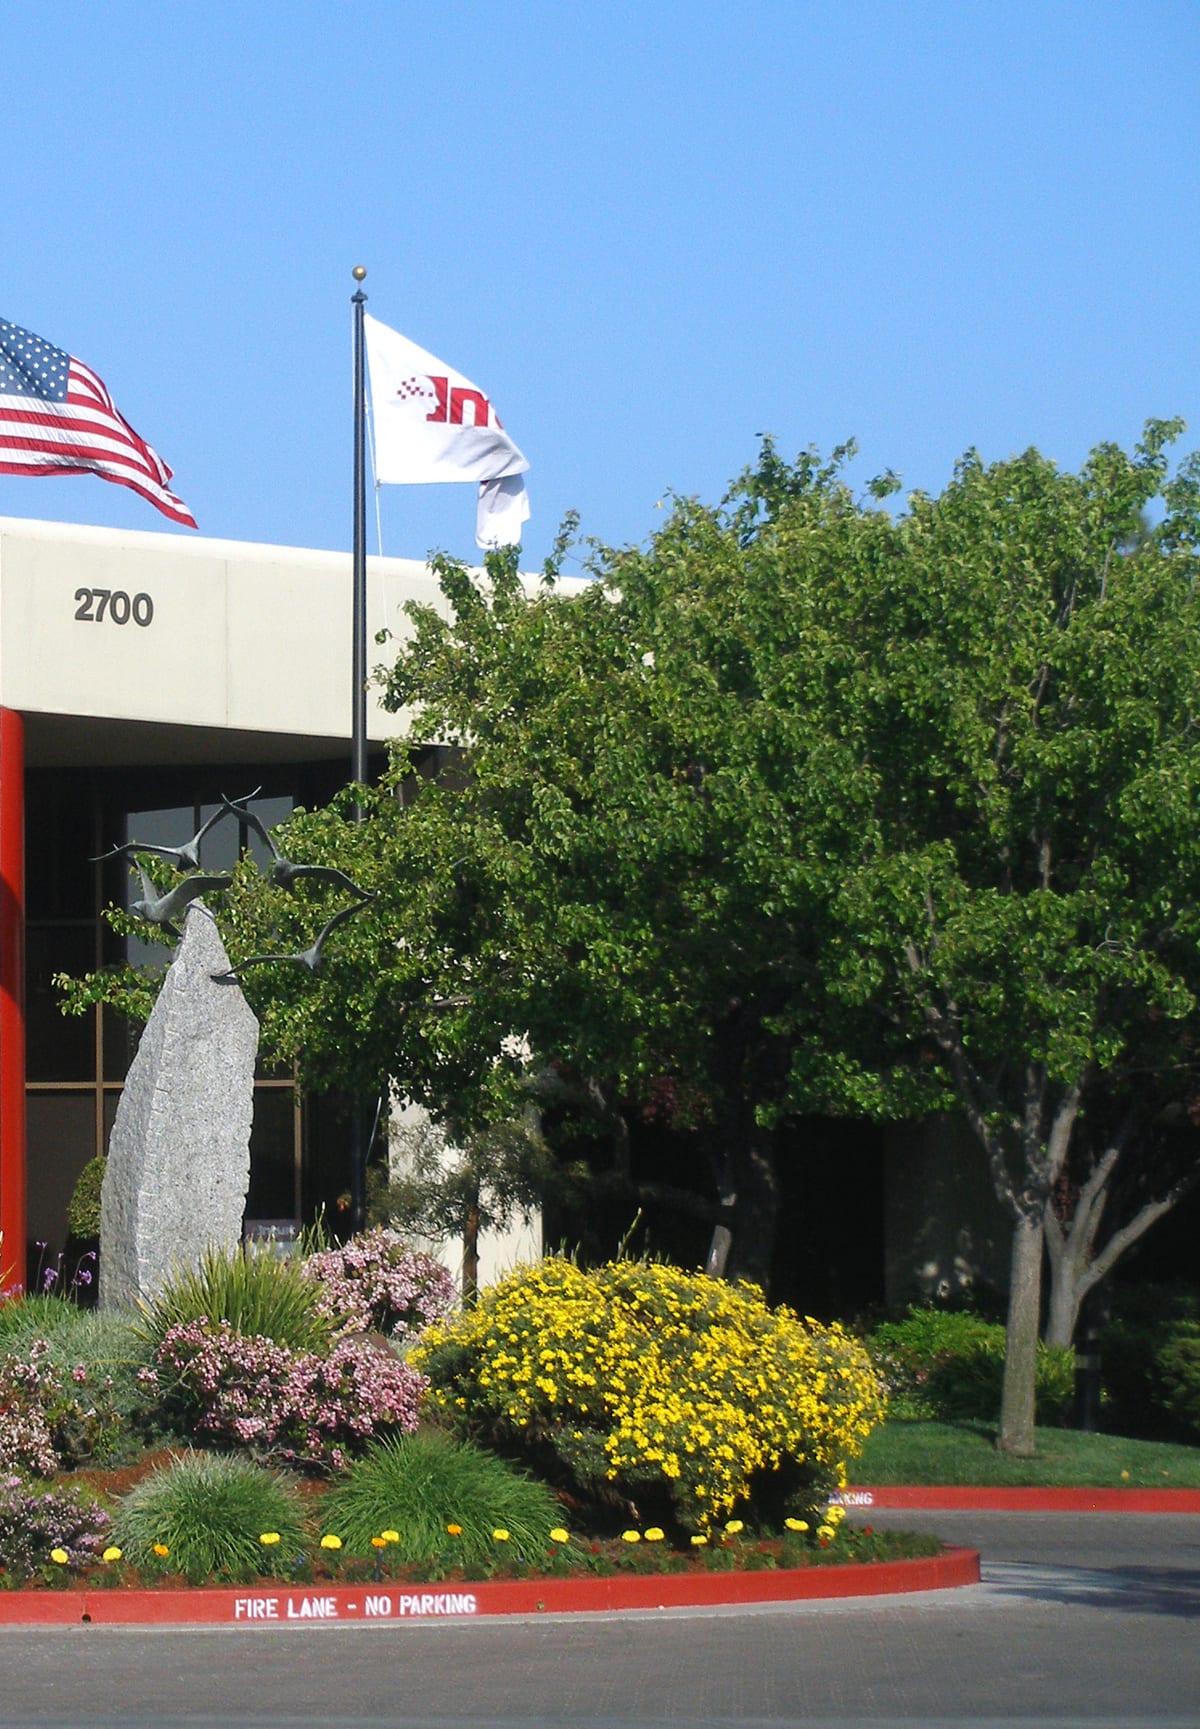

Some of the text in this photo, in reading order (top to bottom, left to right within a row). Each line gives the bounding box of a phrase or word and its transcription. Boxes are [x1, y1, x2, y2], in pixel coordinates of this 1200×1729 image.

[74, 587, 154, 627] 2700
[235, 1598, 278, 1618] FIRE
[287, 1597, 338, 1618] LANE
[365, 1596, 391, 1616] NO
[400, 1593, 477, 1615] PARKING
